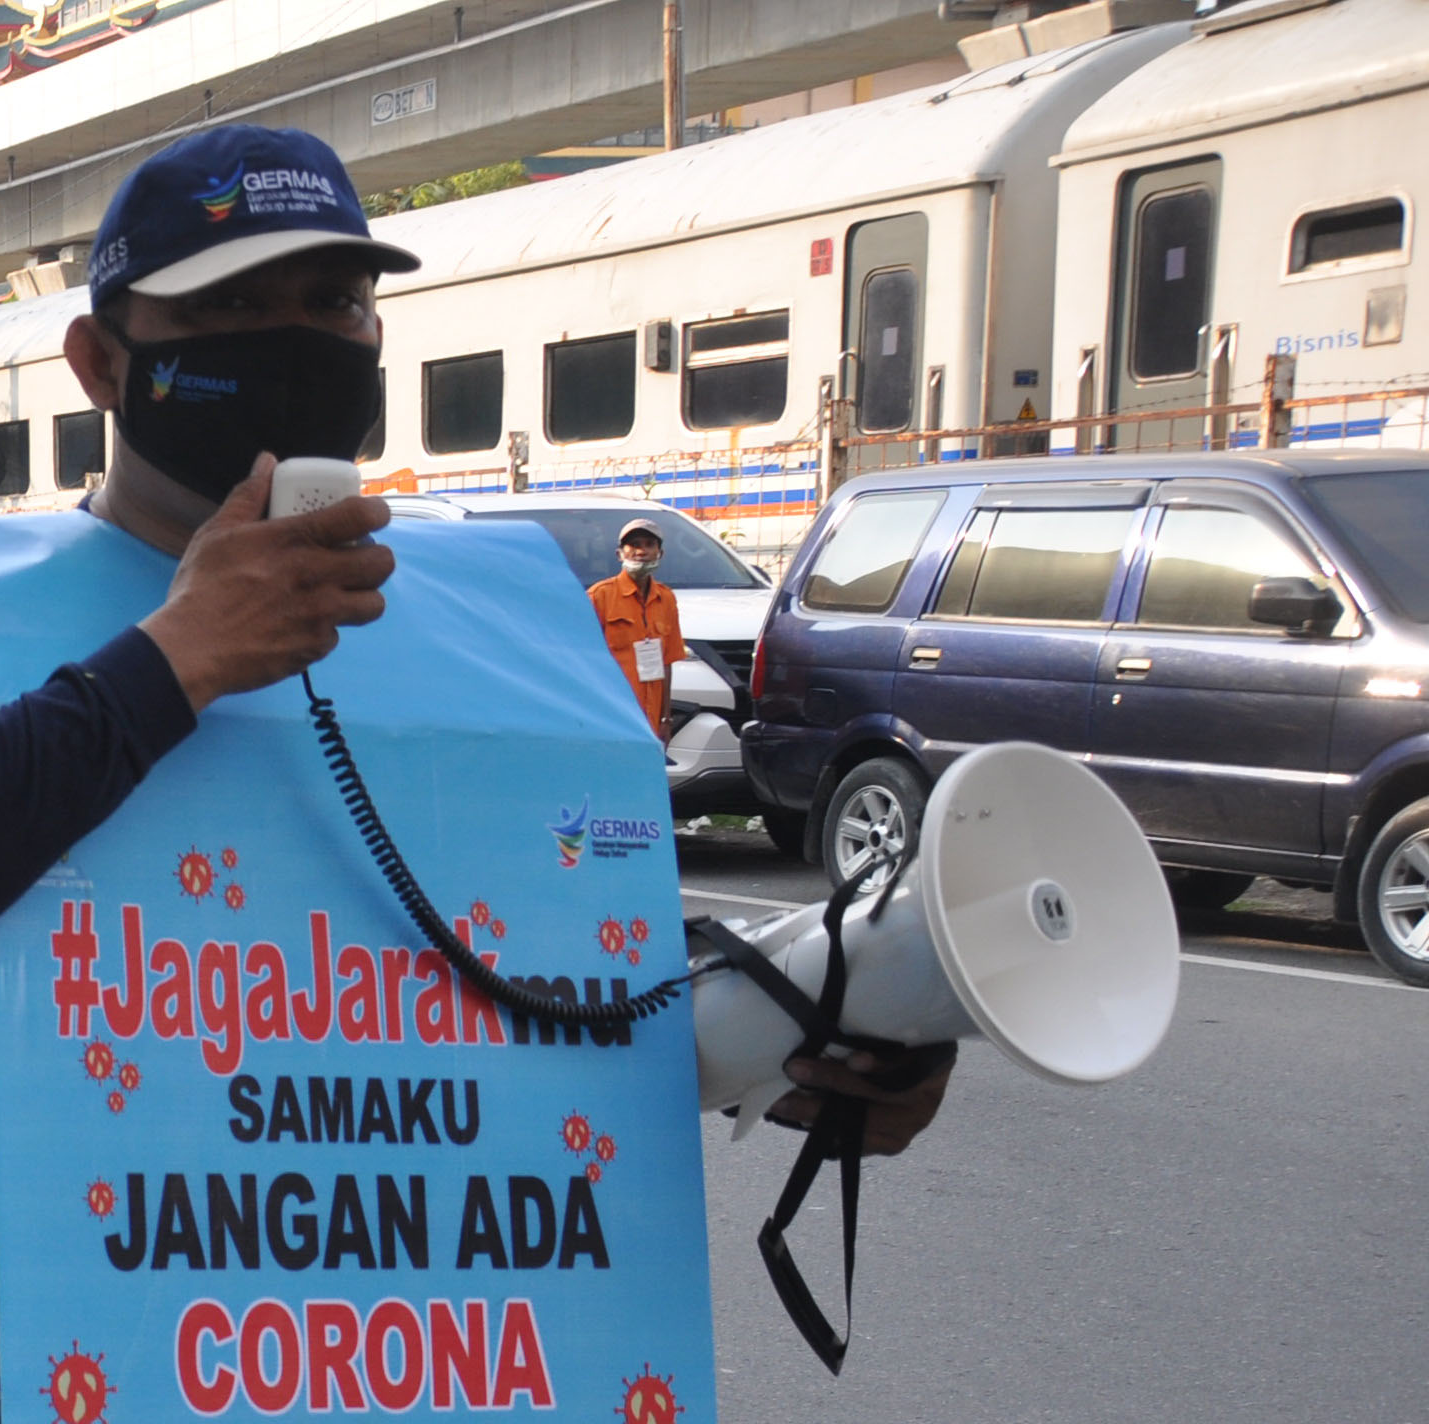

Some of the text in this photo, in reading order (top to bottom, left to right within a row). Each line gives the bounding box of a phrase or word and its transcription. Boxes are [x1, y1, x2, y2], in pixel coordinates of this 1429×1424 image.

[243, 169, 334, 195] GERMAS
[1276, 328, 1358, 355] Bisnis
[590, 819, 660, 840] GERMAS
[229, 1075, 480, 1145] SAMAKU
[104, 1172, 611, 1271] JANGAN ADA
[177, 1300, 554, 1414] CORONA
